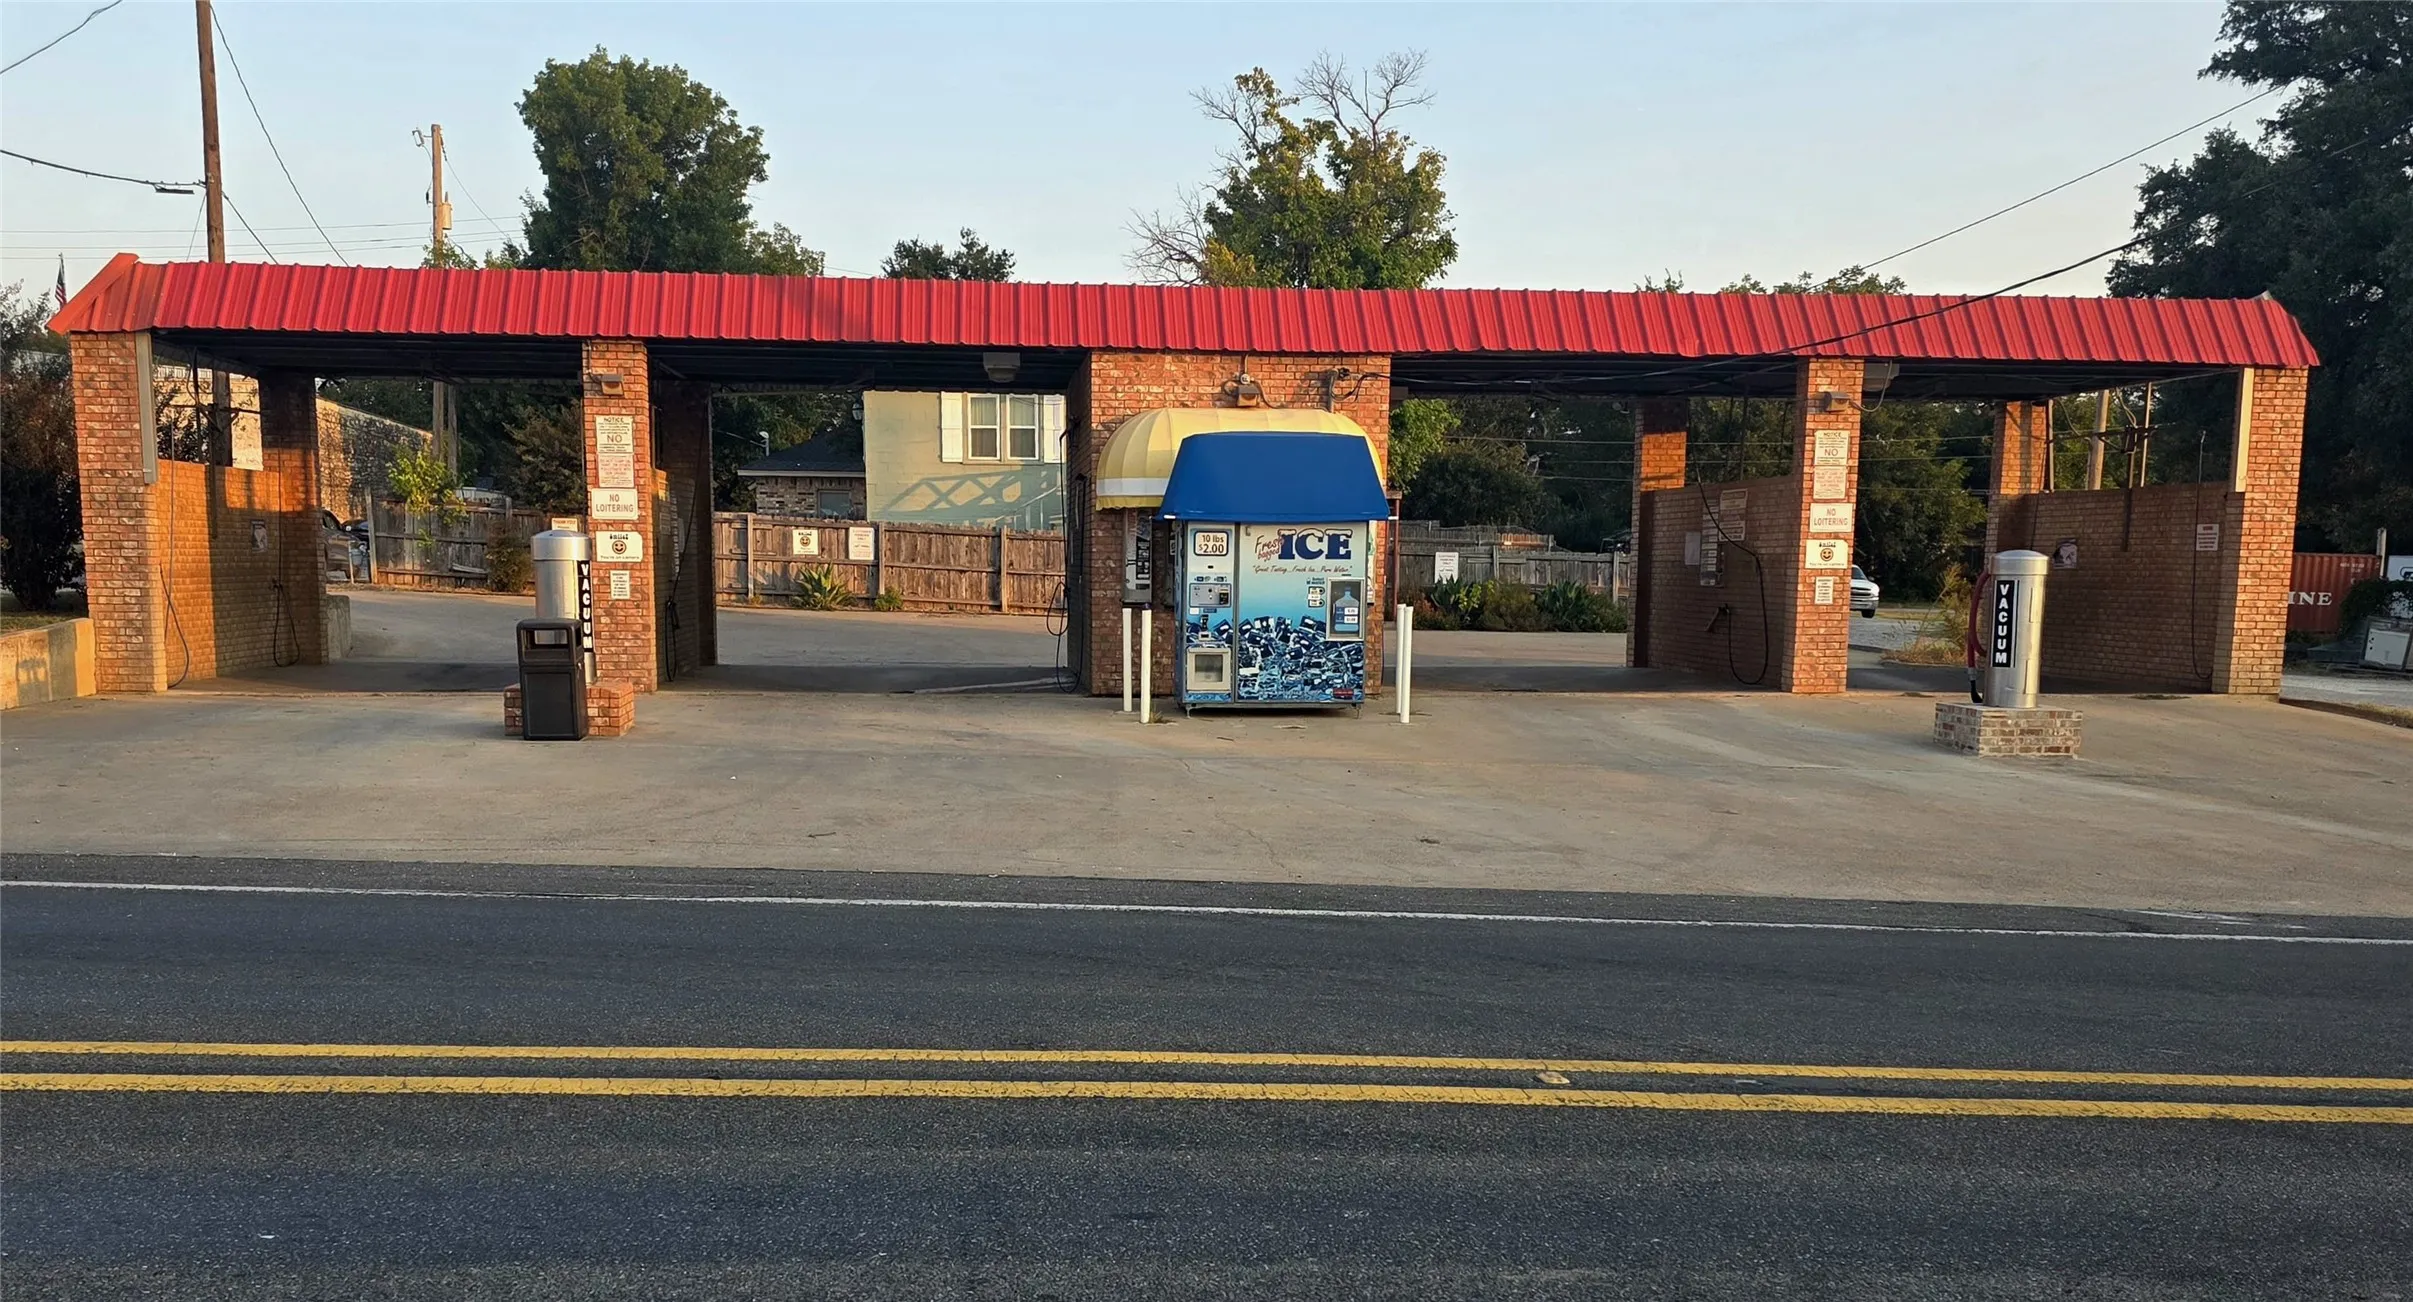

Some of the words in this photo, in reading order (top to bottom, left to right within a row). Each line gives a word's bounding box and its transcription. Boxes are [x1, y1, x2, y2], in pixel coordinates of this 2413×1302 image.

[606, 434, 623, 443] NO
[1824, 448, 1839, 457] NO
[609, 494, 620, 502] NO
[595, 504, 634, 512] LOITERING
[1826, 508, 1836, 516] NO
[1813, 517, 1848, 526] LOITERING
[1202, 534, 1211, 543] 10
[1212, 534, 1224, 543] lbs
[1198, 543, 1224, 553] $2.00
[1254, 535, 1284, 553] Fresh
[1278, 528, 1353, 560] ICE
[581, 563, 593, 649] VACUUM
[1995, 584, 2010, 664] VACUUM
